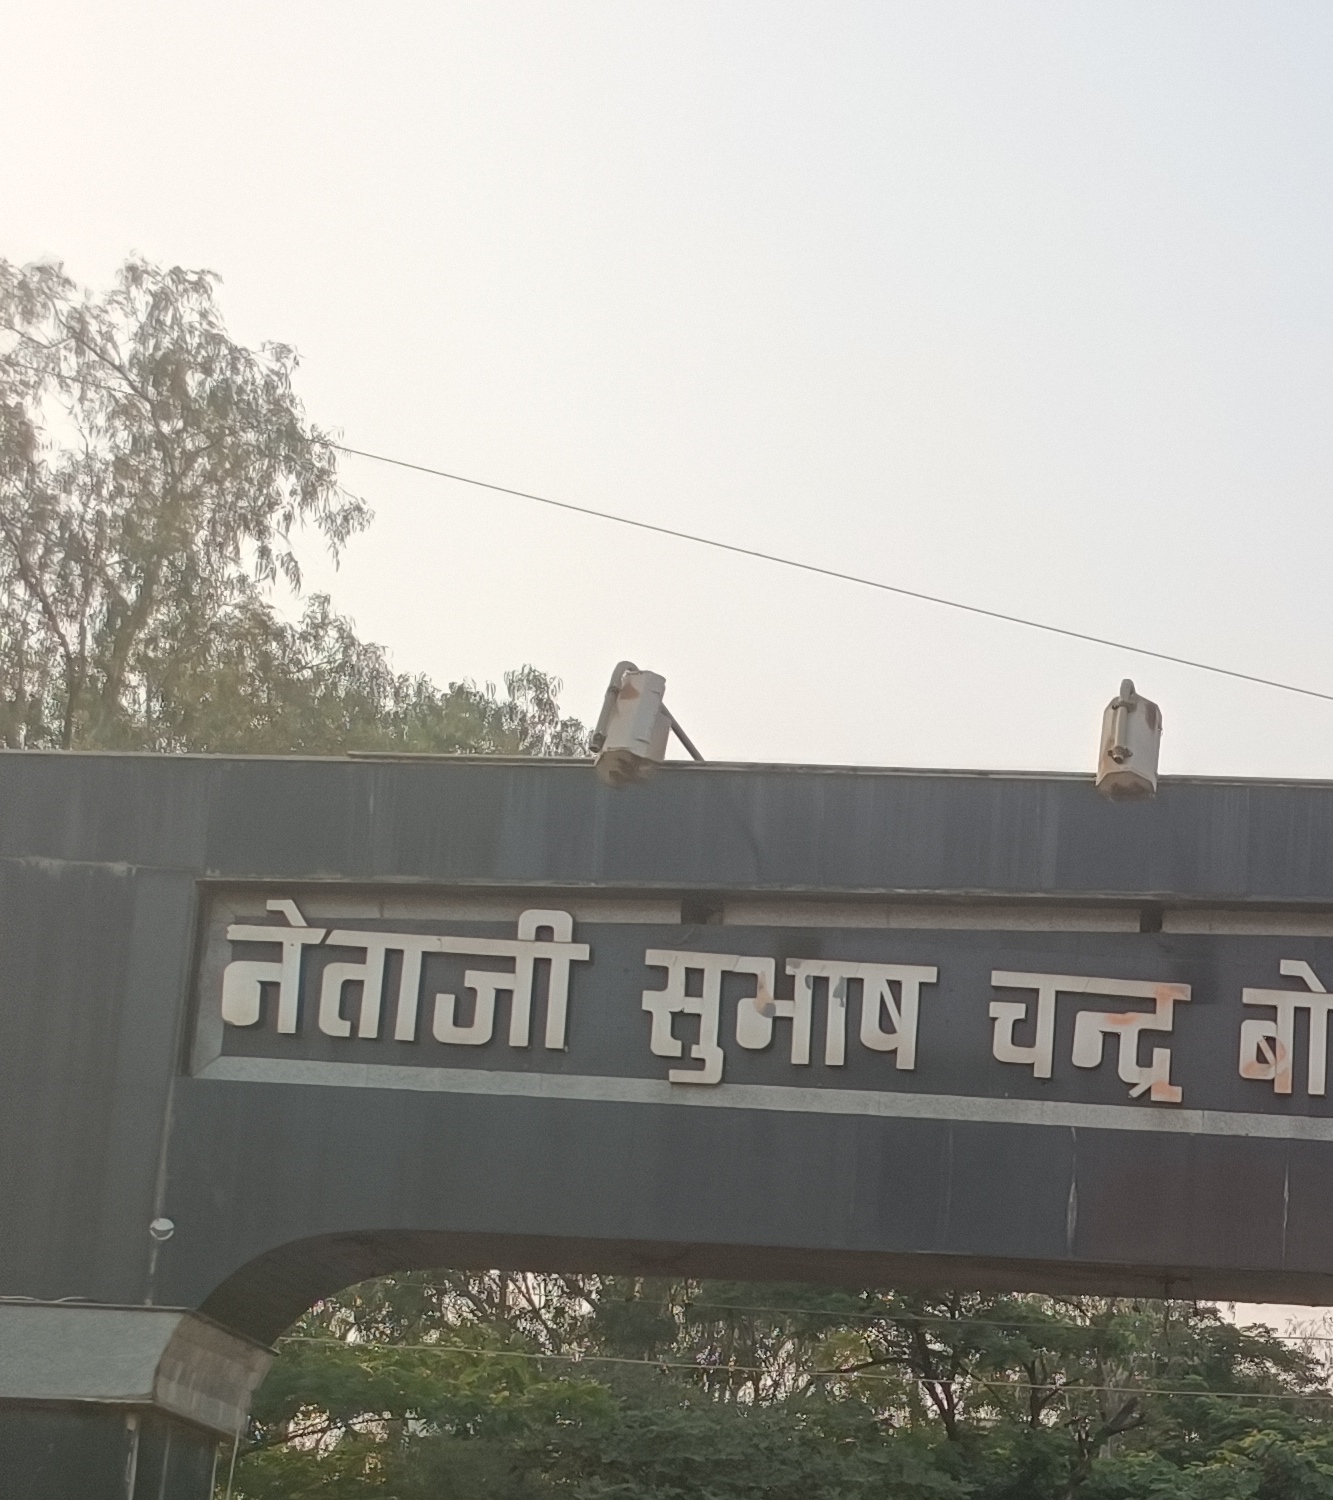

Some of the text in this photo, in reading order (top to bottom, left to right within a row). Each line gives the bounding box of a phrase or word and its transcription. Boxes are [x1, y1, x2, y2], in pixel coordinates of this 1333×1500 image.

[221, 898, 591, 1050] नेताजी
[641, 948, 939, 1086] सुभाष
[989, 969, 1192, 1103] चन्द्र
